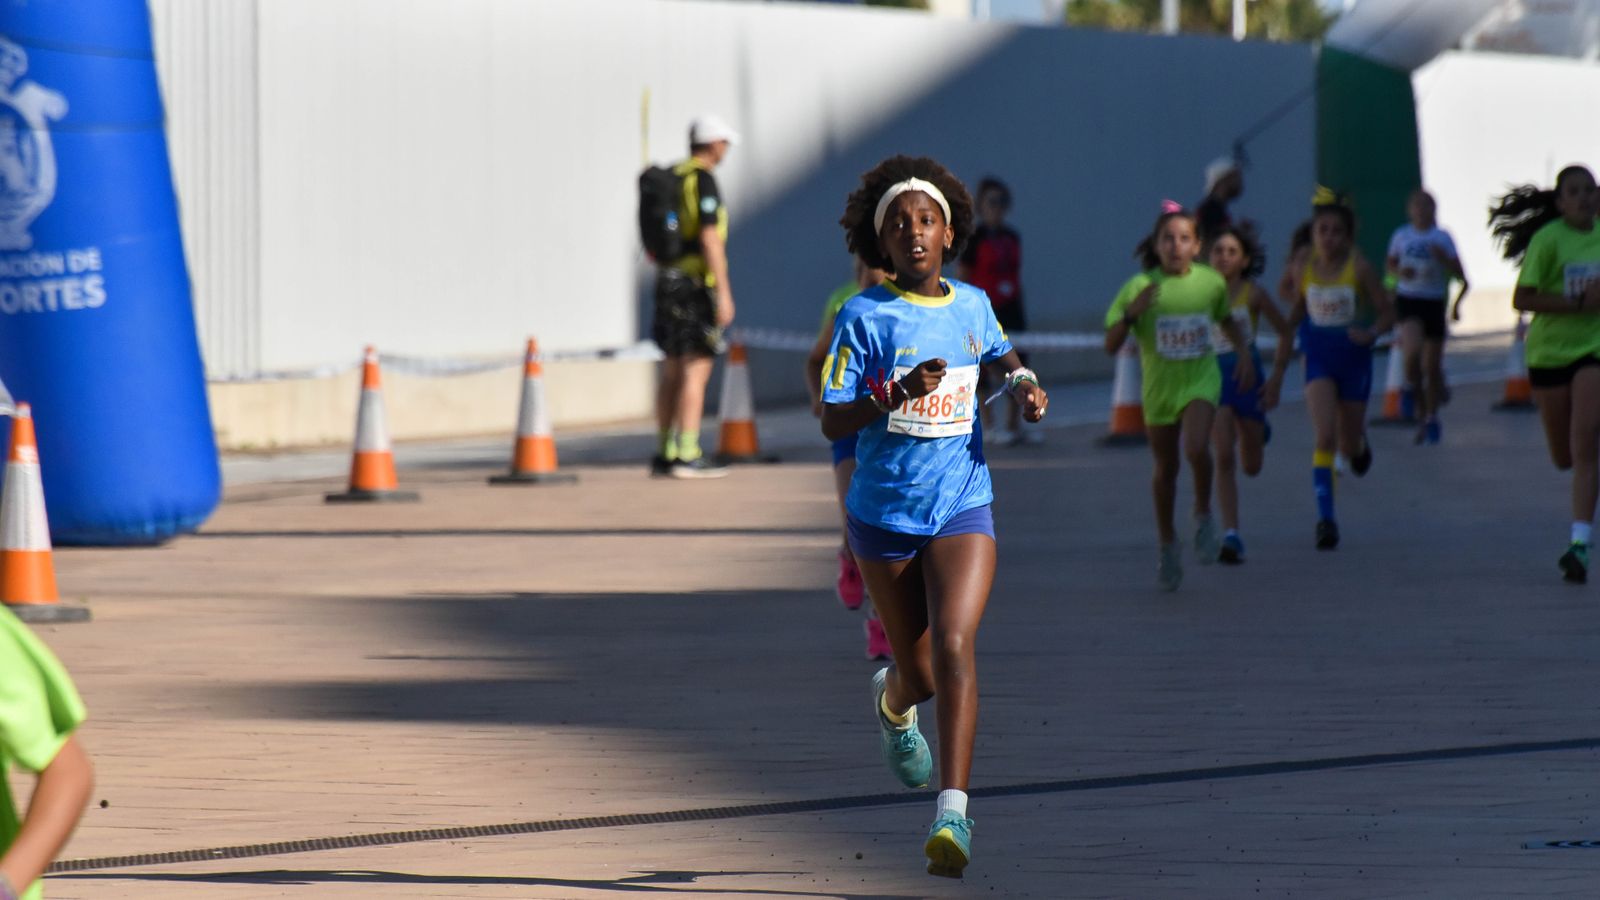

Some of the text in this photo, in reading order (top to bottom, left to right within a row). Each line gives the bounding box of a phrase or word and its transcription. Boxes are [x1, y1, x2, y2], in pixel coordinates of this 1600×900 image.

[67, 248, 102, 273] DE
[0, 273, 107, 314] ORTES
[902, 394, 953, 417] 1486
